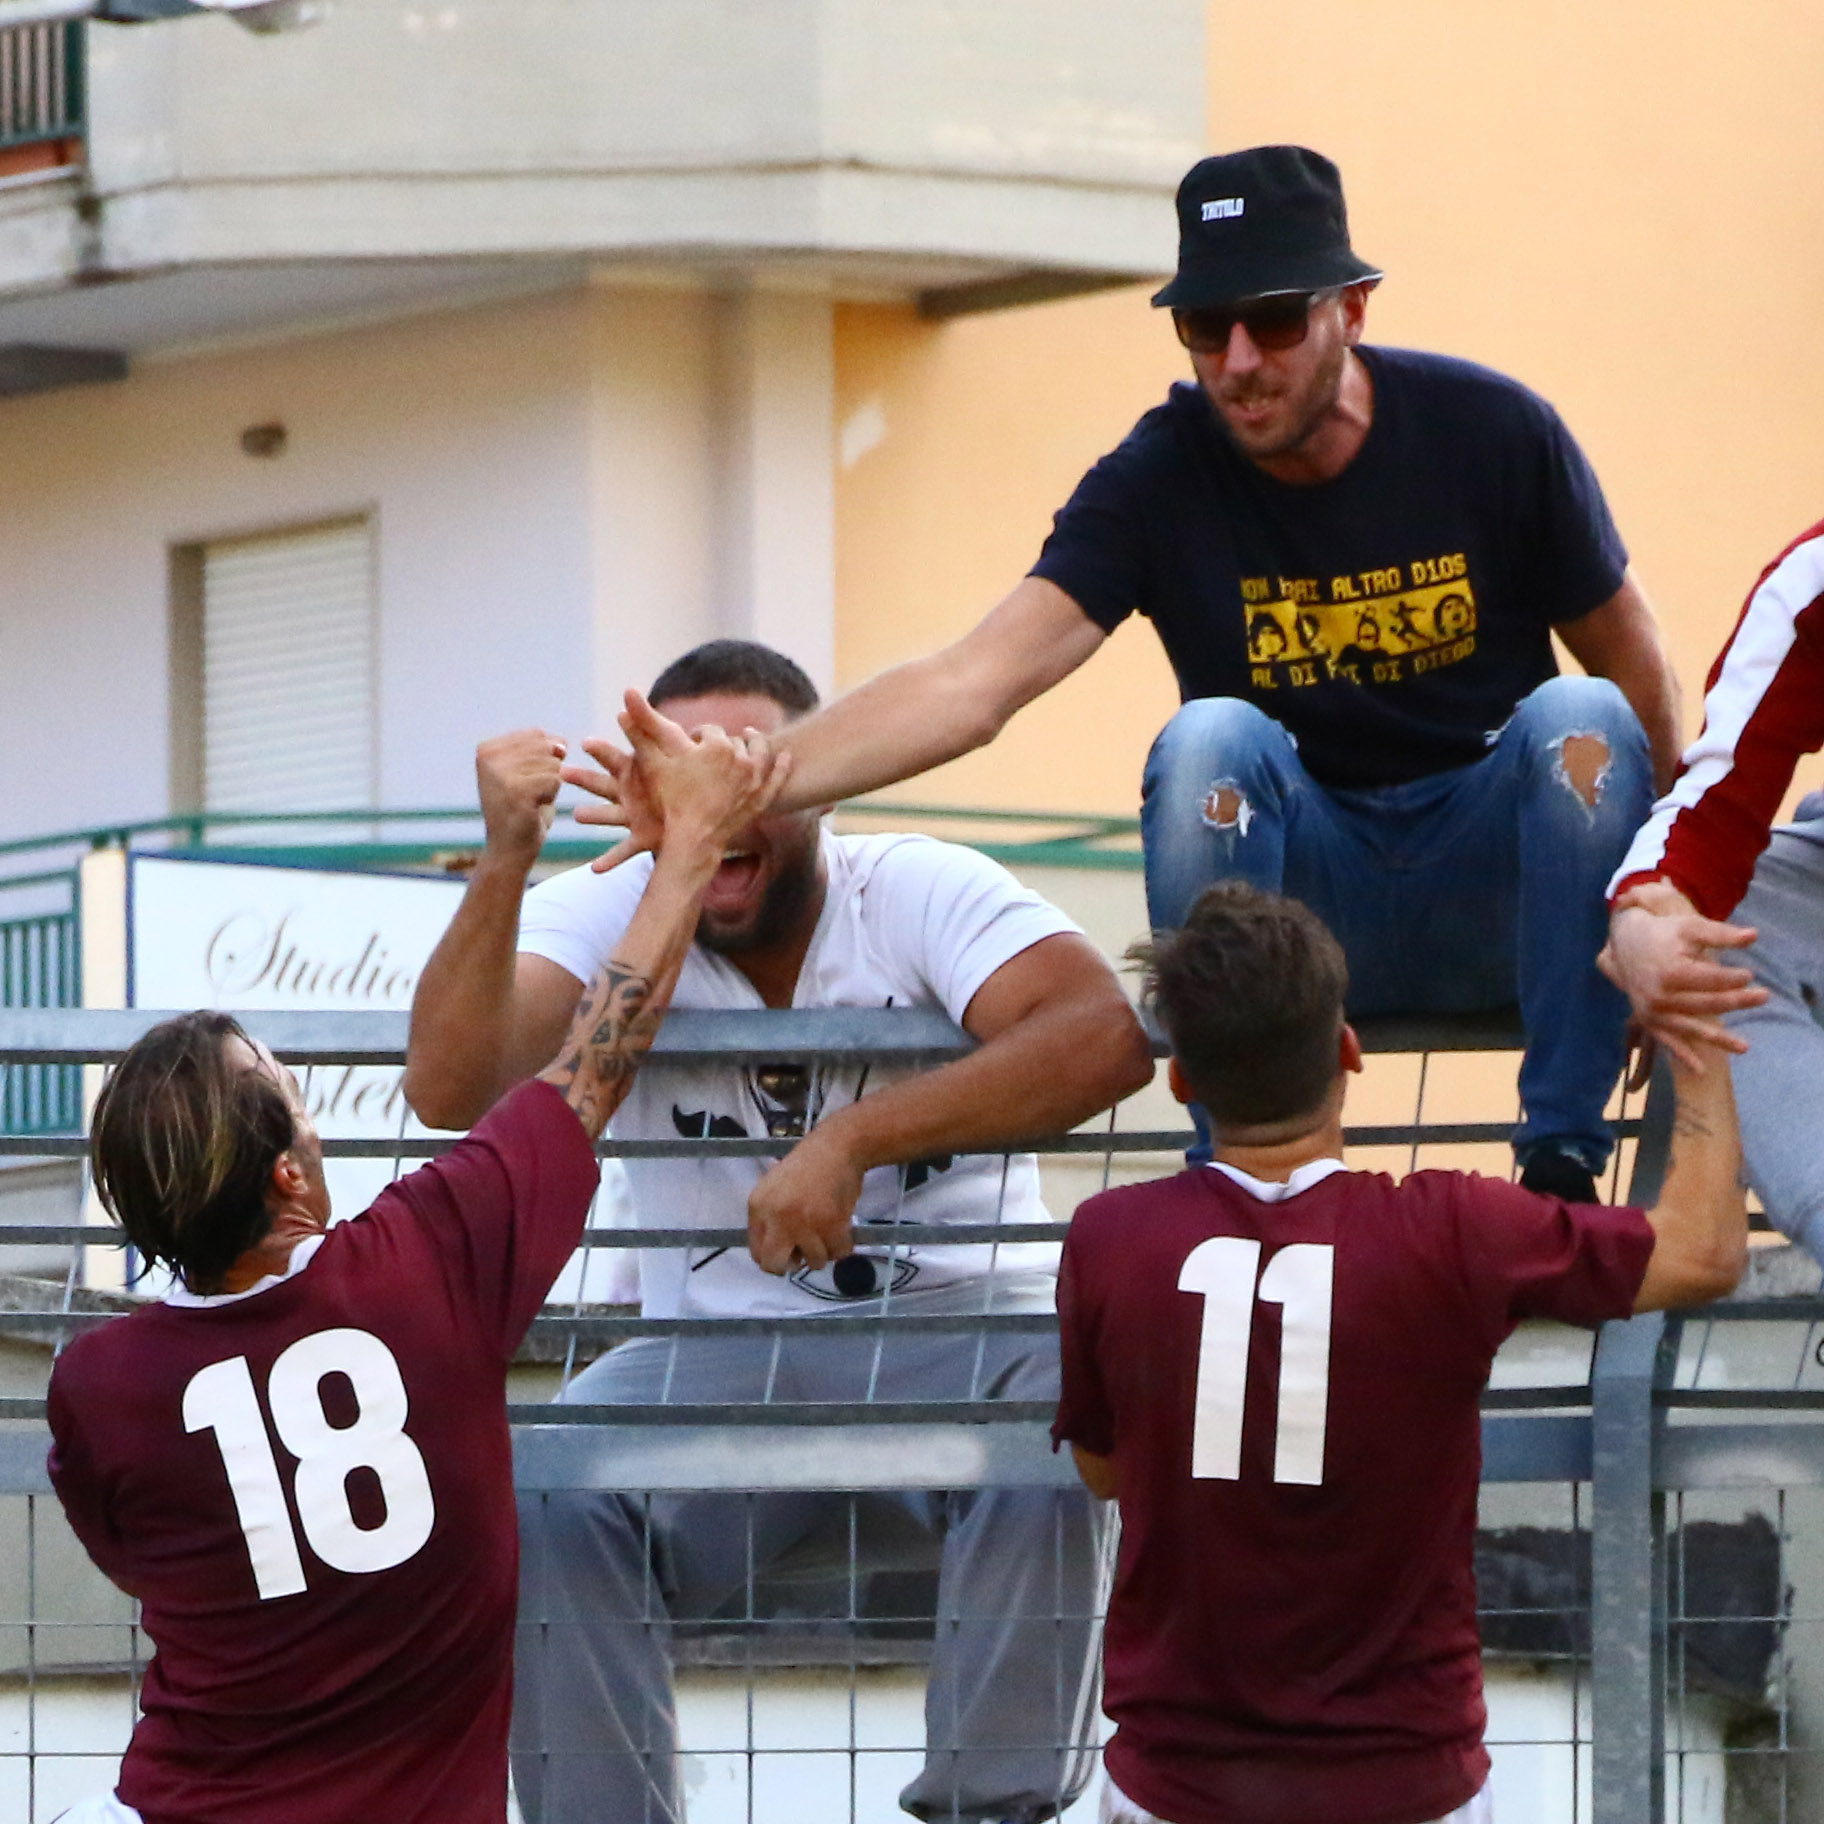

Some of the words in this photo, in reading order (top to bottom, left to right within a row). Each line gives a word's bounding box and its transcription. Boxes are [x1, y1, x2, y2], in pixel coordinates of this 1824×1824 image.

[1332, 566, 1402, 601] ALTRO
[1289, 661, 1319, 687] DI
[205, 903, 414, 1004] Studio
[1177, 1236, 1335, 1486] 11
[182, 1328, 435, 1600] 18
